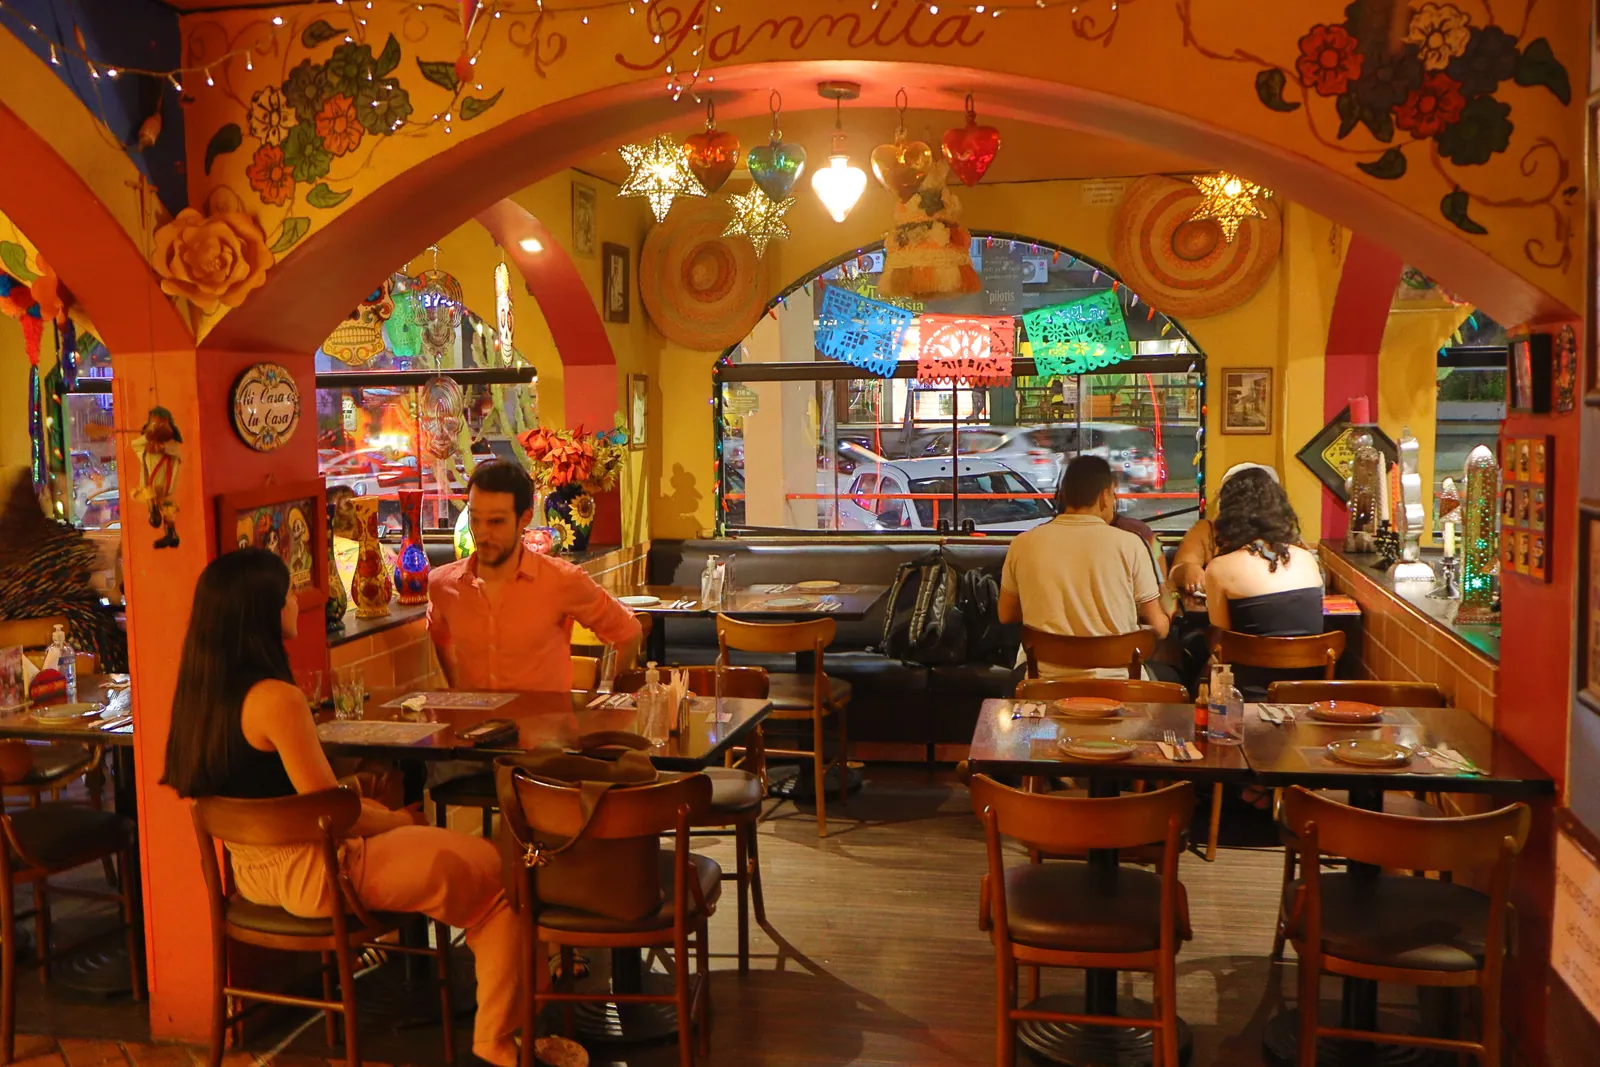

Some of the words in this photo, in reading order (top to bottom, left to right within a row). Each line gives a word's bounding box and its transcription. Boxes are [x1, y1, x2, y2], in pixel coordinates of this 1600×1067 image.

[989, 289, 1015, 304] pilotis
[260, 387, 285, 404] Casa
[264, 408, 289, 426] Casa
